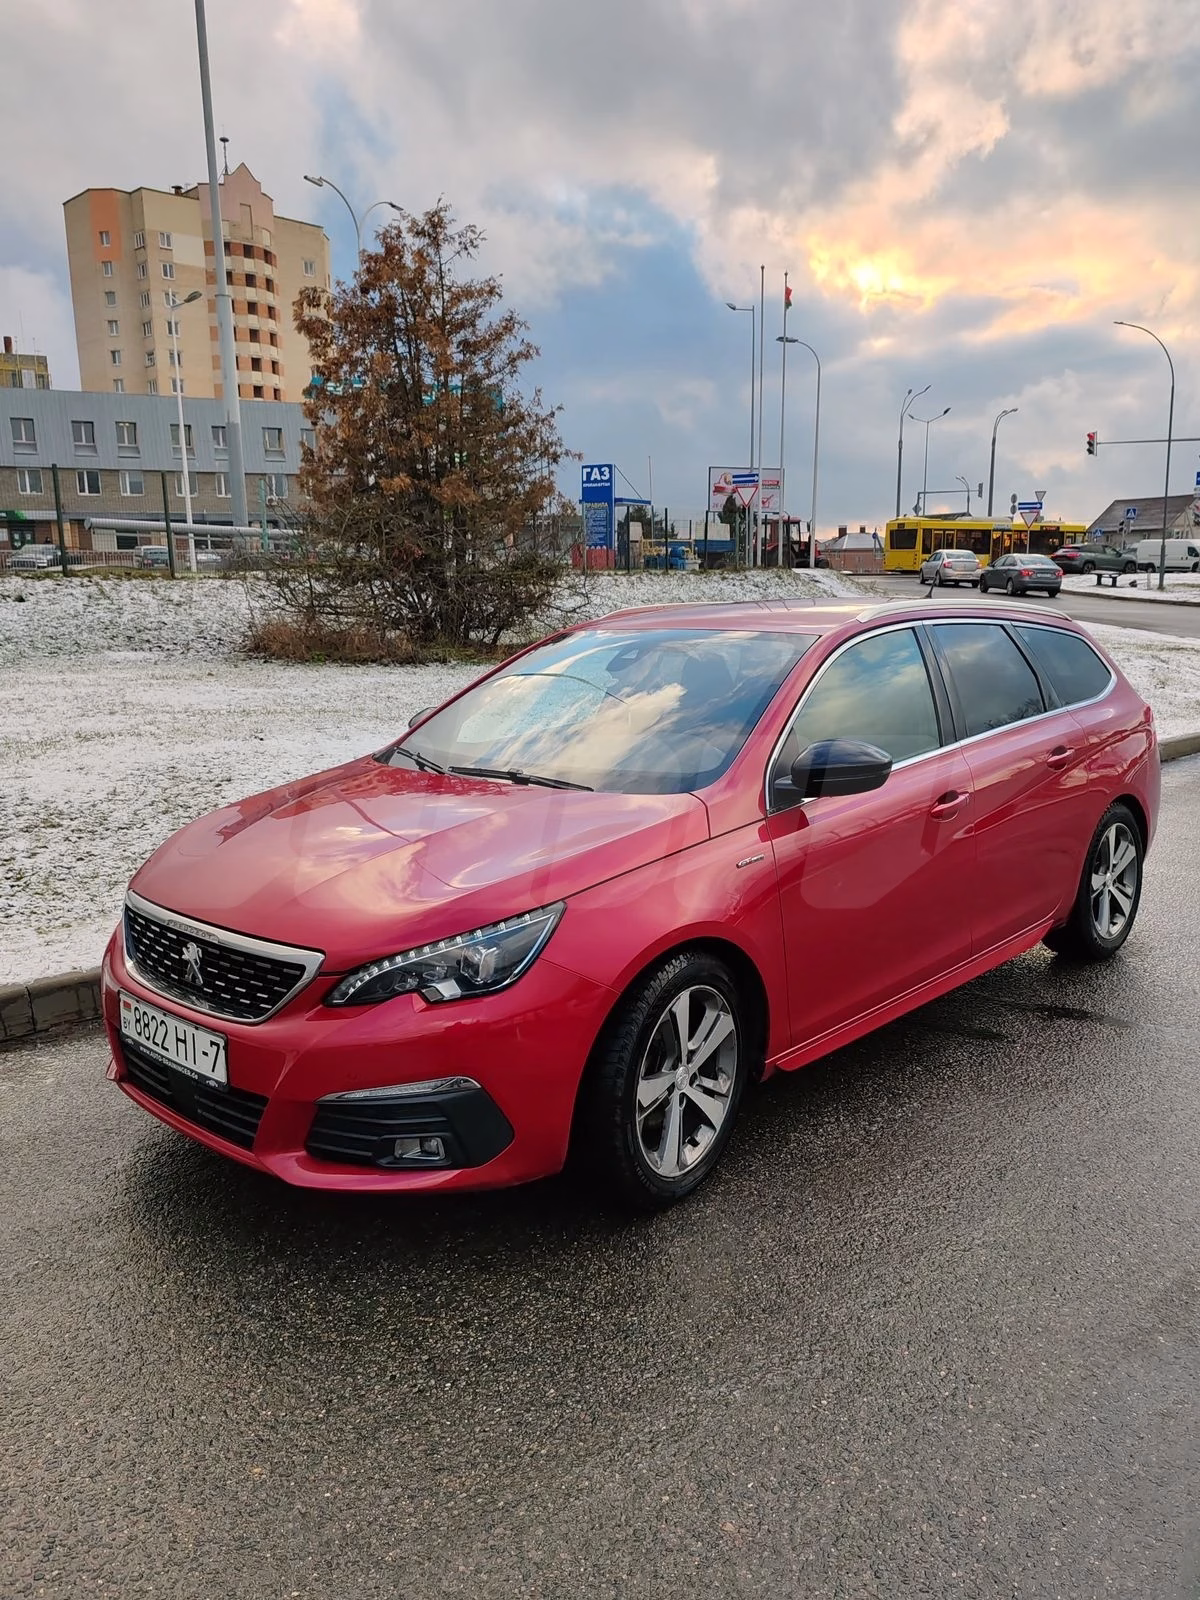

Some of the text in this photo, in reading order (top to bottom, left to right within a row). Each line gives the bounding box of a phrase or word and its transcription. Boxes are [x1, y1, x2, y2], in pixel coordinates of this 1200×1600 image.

[582, 466, 610, 482] ГАЗ
[167, 919, 212, 940] PEUGEOT
[123, 1016, 131, 1031] BY
[133, 1006, 170, 1053] 8822
[174, 1025, 221, 1073] HI-7
